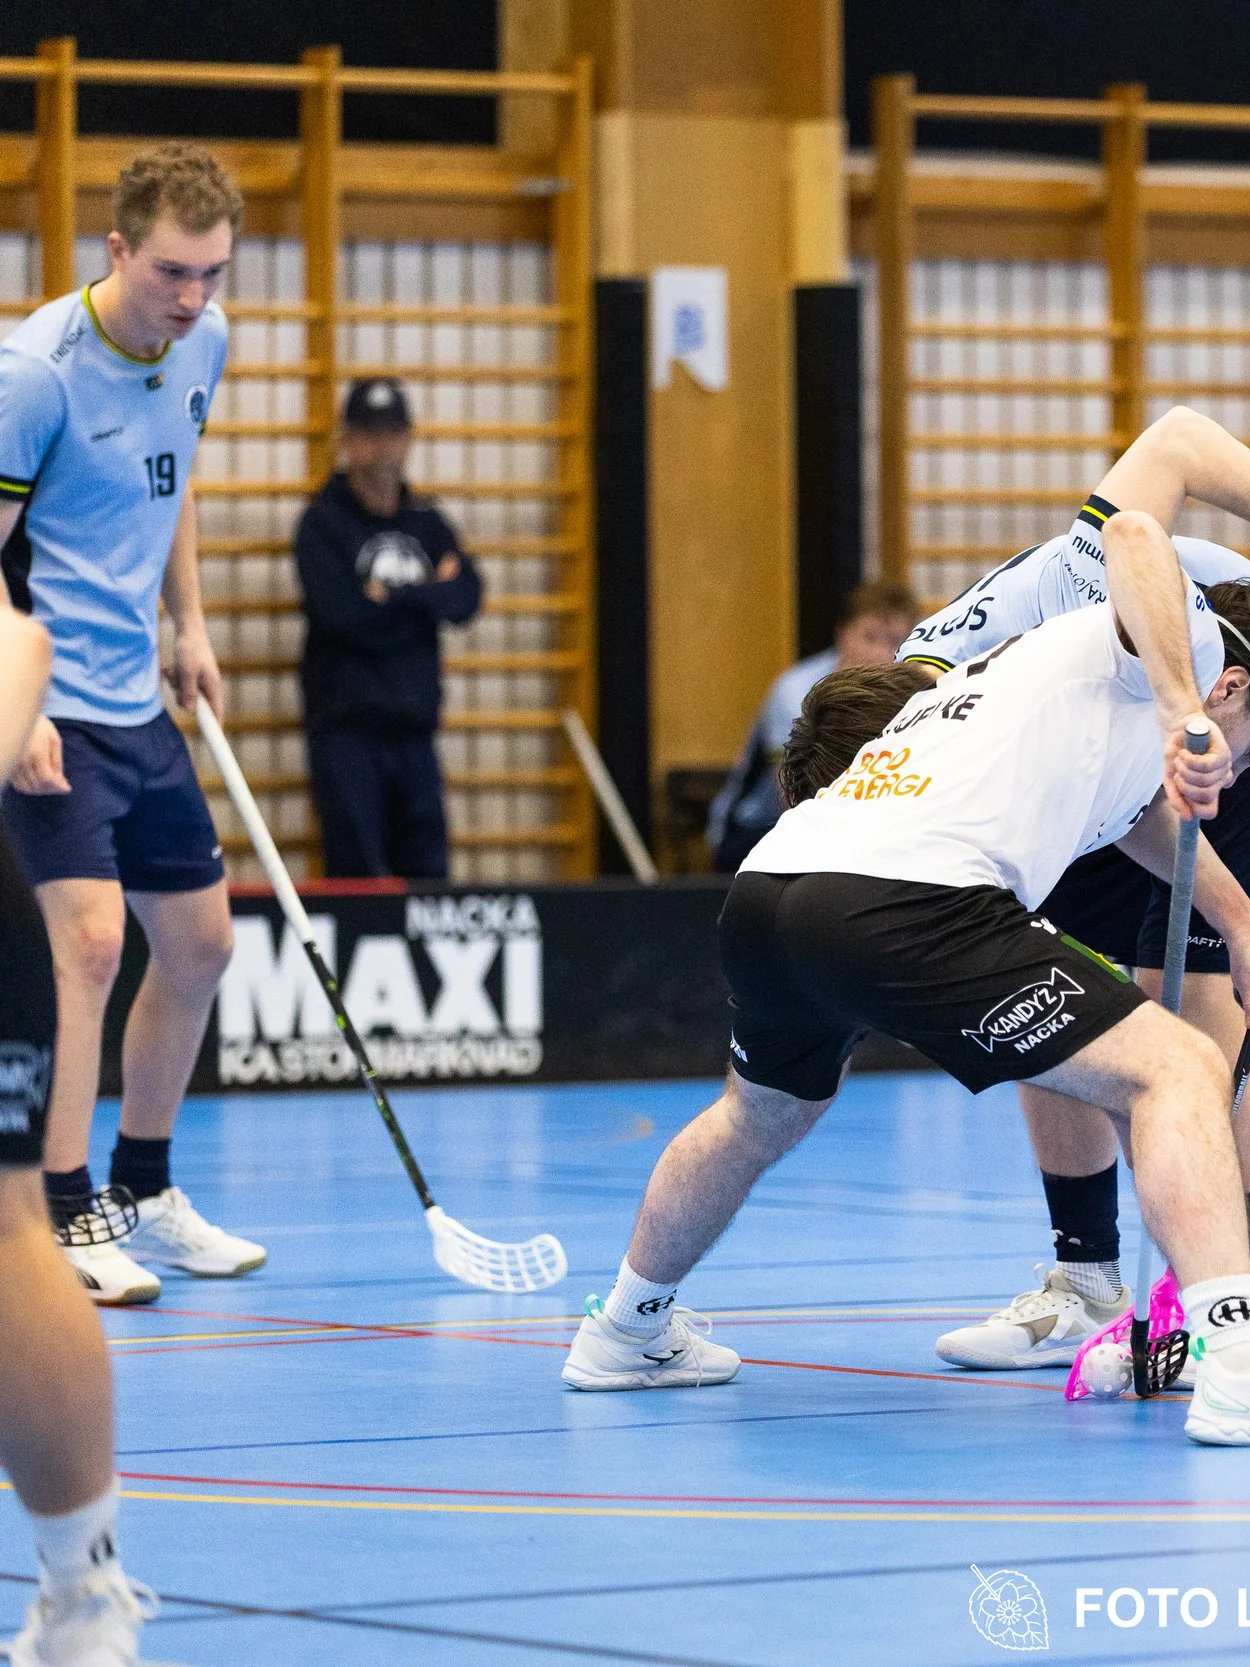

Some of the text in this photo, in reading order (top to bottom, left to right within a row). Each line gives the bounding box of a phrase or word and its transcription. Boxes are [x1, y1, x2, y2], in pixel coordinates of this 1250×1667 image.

[144, 452, 176, 500] 19
[1072, 535, 1106, 567] amlu
[405, 894, 540, 938] NACKA
[217, 914, 543, 1040] MAXI
[1013, 1012, 1076, 1054] NACKA
